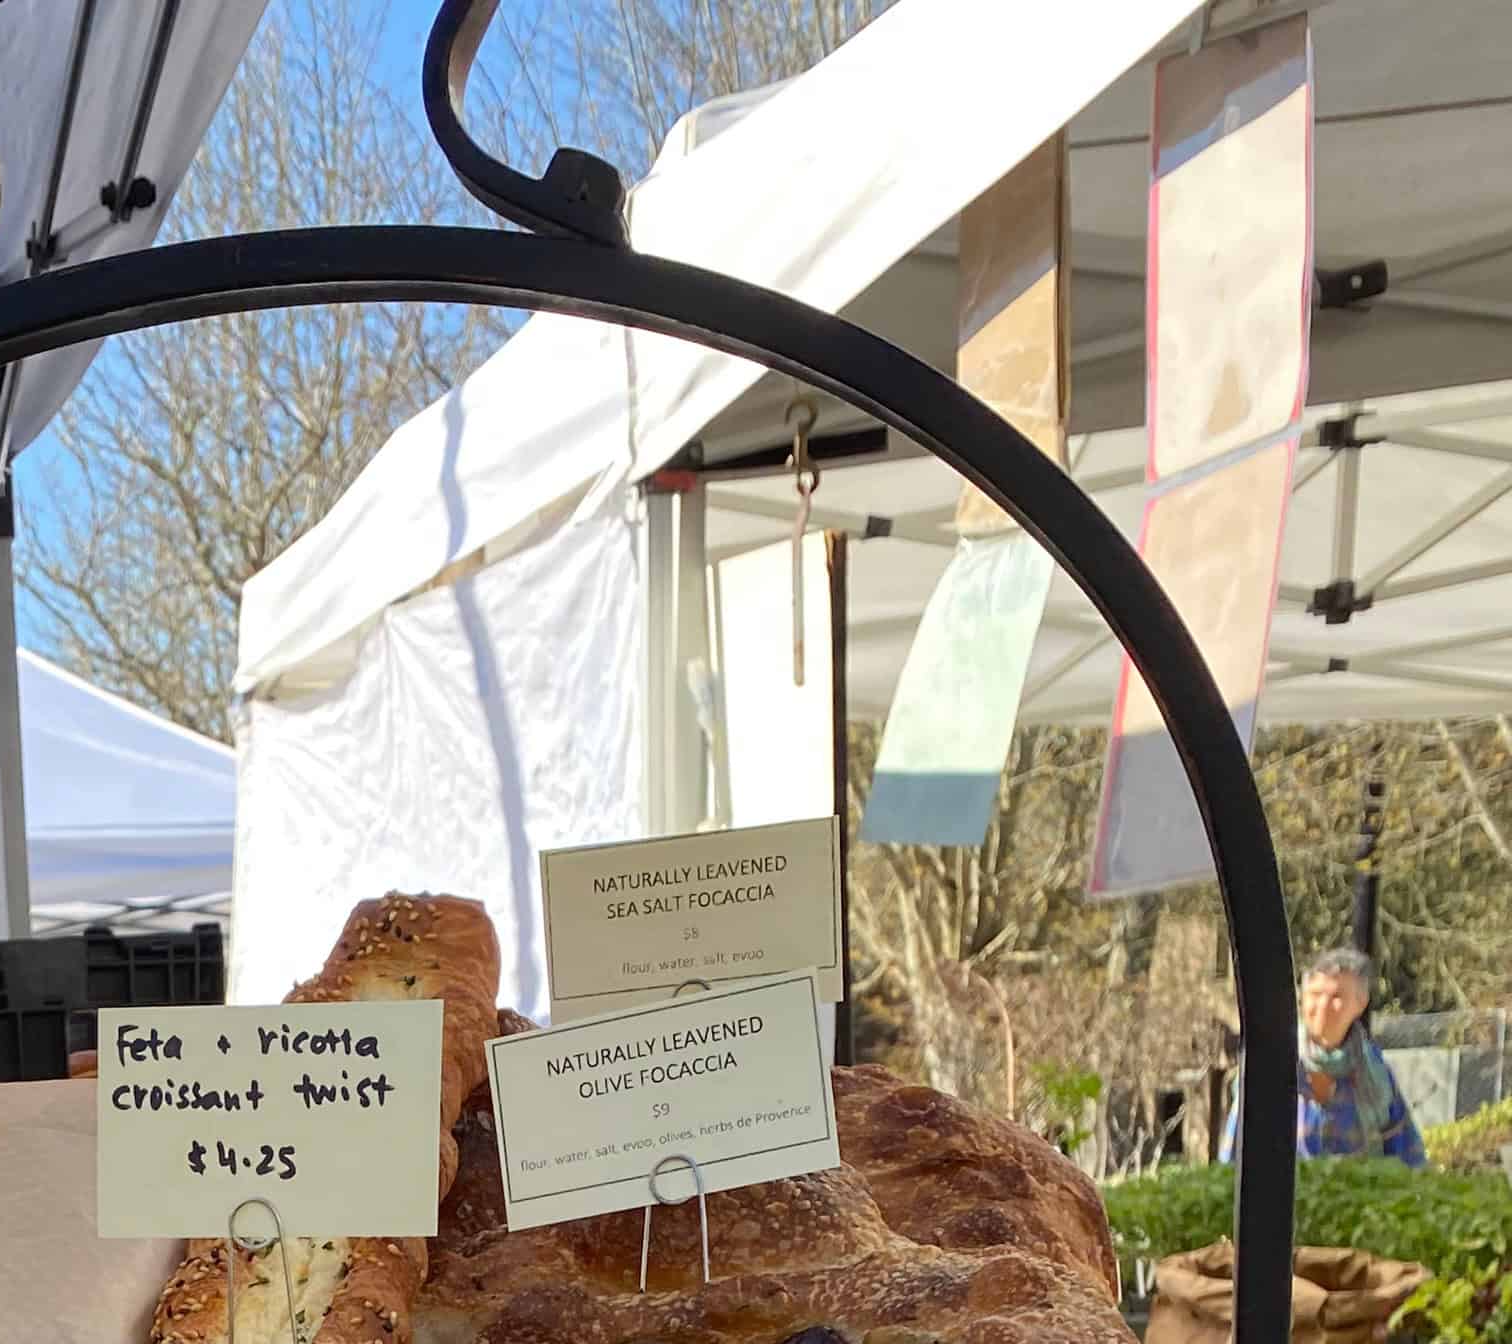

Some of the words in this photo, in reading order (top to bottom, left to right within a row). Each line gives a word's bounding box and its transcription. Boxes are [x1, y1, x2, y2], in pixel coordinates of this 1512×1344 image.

[592, 866, 691, 893] NATURALLY
[696, 854, 787, 881] LEAVENED
[606, 900, 639, 919] SEA
[642, 894, 683, 915] SALT
[687, 883, 774, 909] FOCACCIA
[115, 1024, 183, 1067] Feta
[256, 1023, 380, 1059] ricotta
[546, 1037, 656, 1076] NATURALLY
[661, 1015, 763, 1052] LEAVENED
[111, 1077, 264, 1112] croissant
[292, 1069, 395, 1109] twist
[578, 1071, 634, 1098] OLIVE
[639, 1050, 738, 1086] FOCACCIA
[651, 1101, 670, 1119] $9
[735, 1115, 752, 1129] de
[754, 1104, 811, 1125] Provence
[187, 1139, 296, 1180] $4.25
